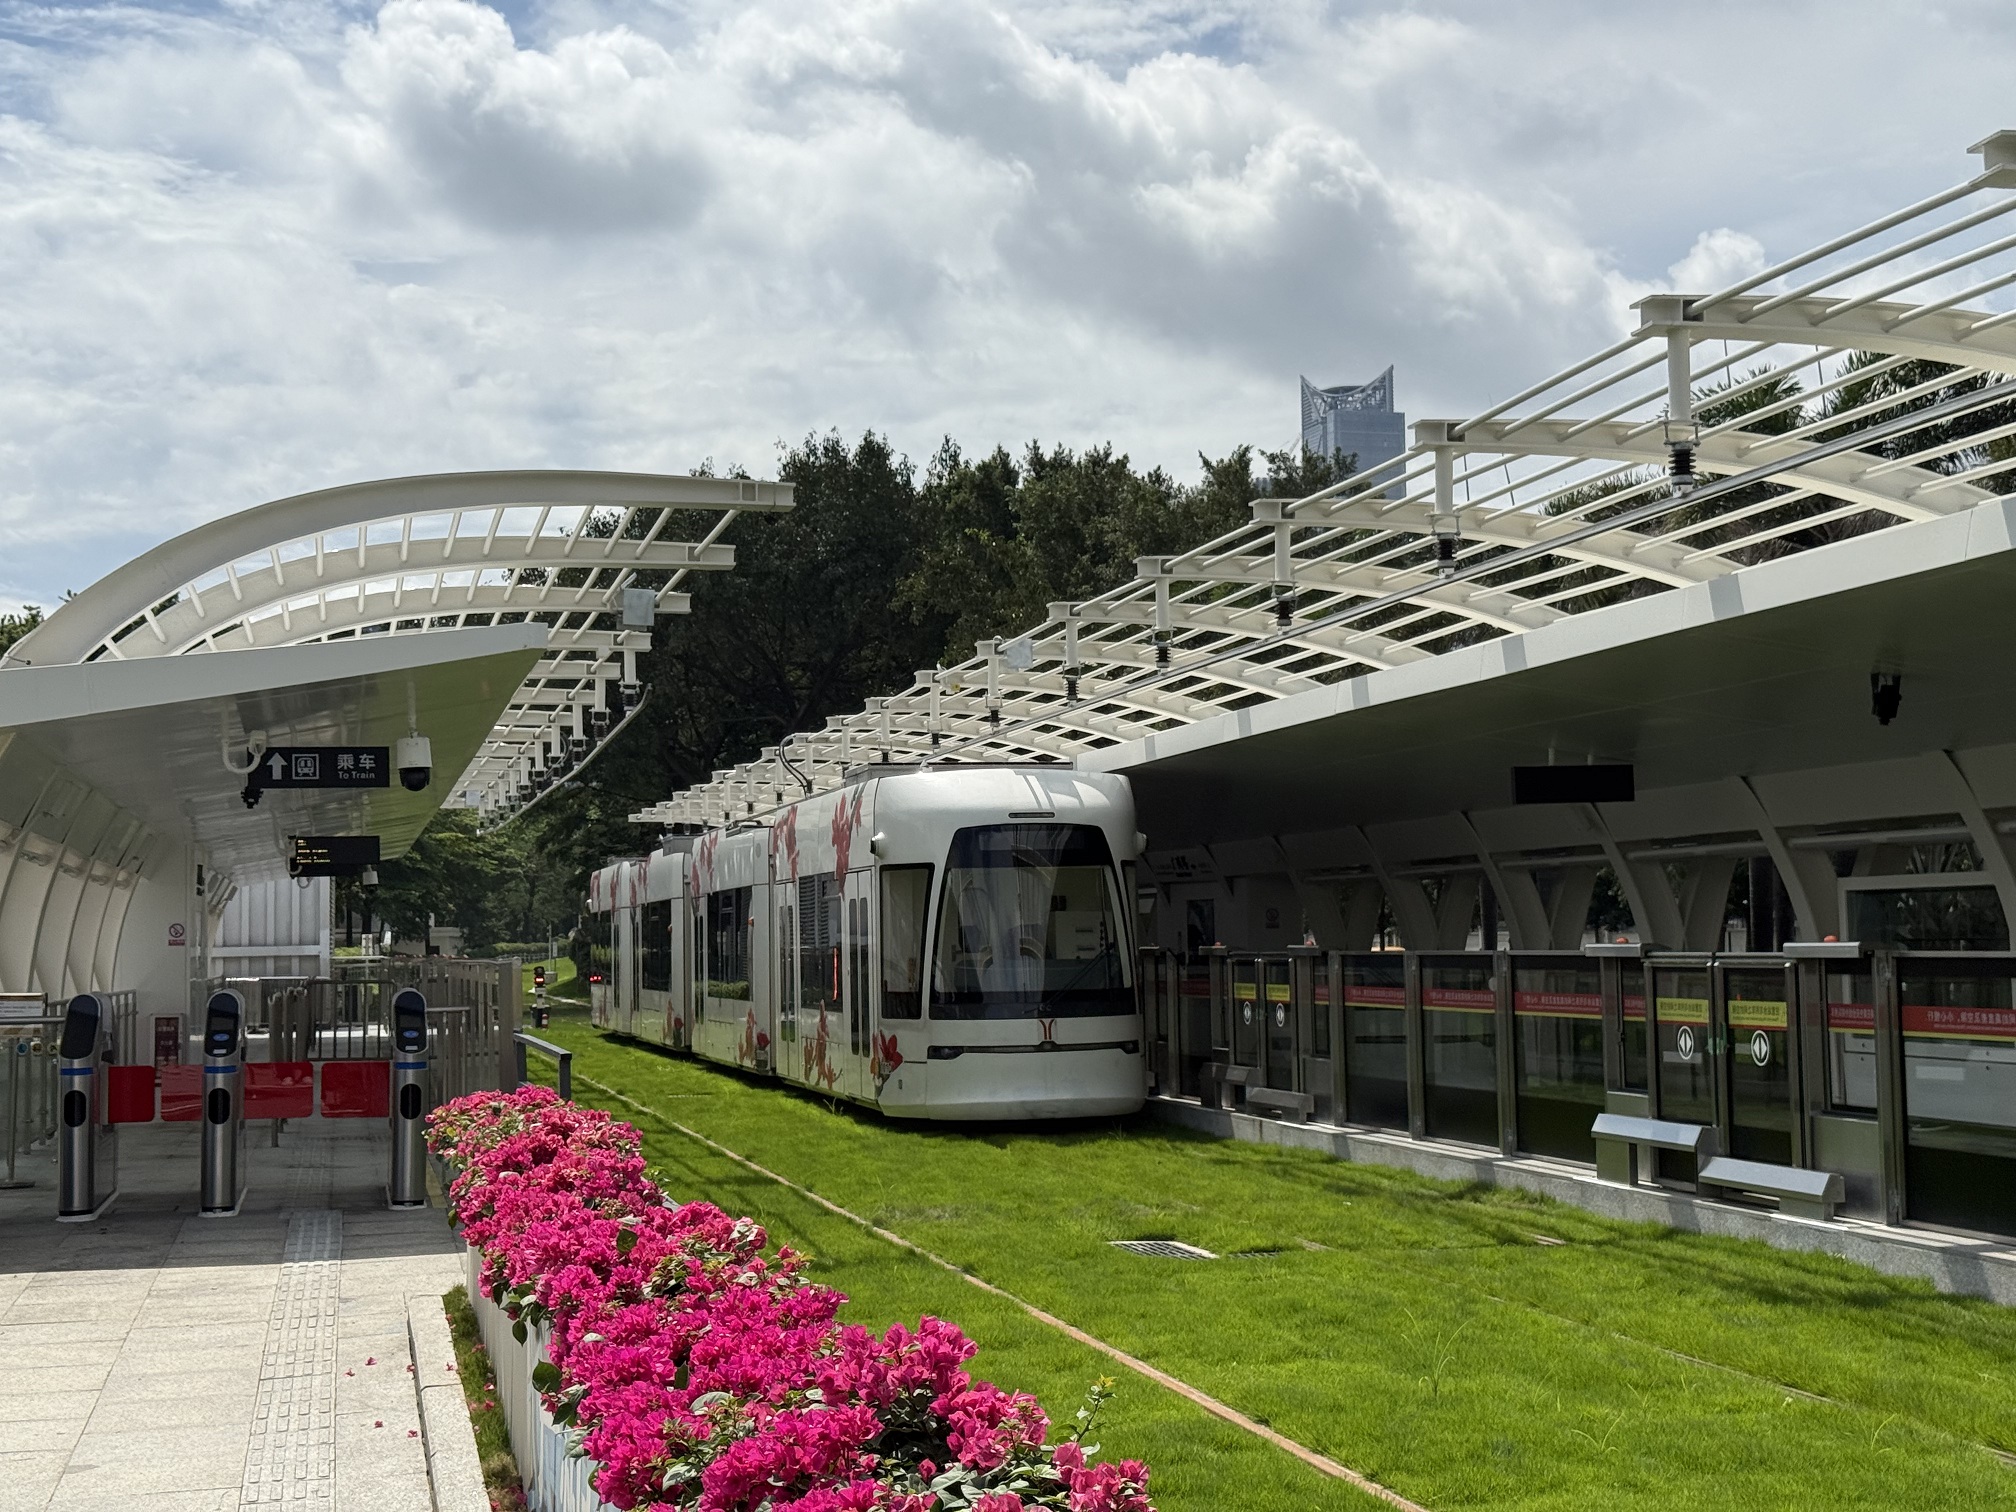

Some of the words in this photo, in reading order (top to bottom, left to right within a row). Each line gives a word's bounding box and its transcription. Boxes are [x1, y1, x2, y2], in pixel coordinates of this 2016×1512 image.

[337, 753, 376, 770] 乘车
[338, 771, 350, 779] To
[351, 771, 376, 779] Train
